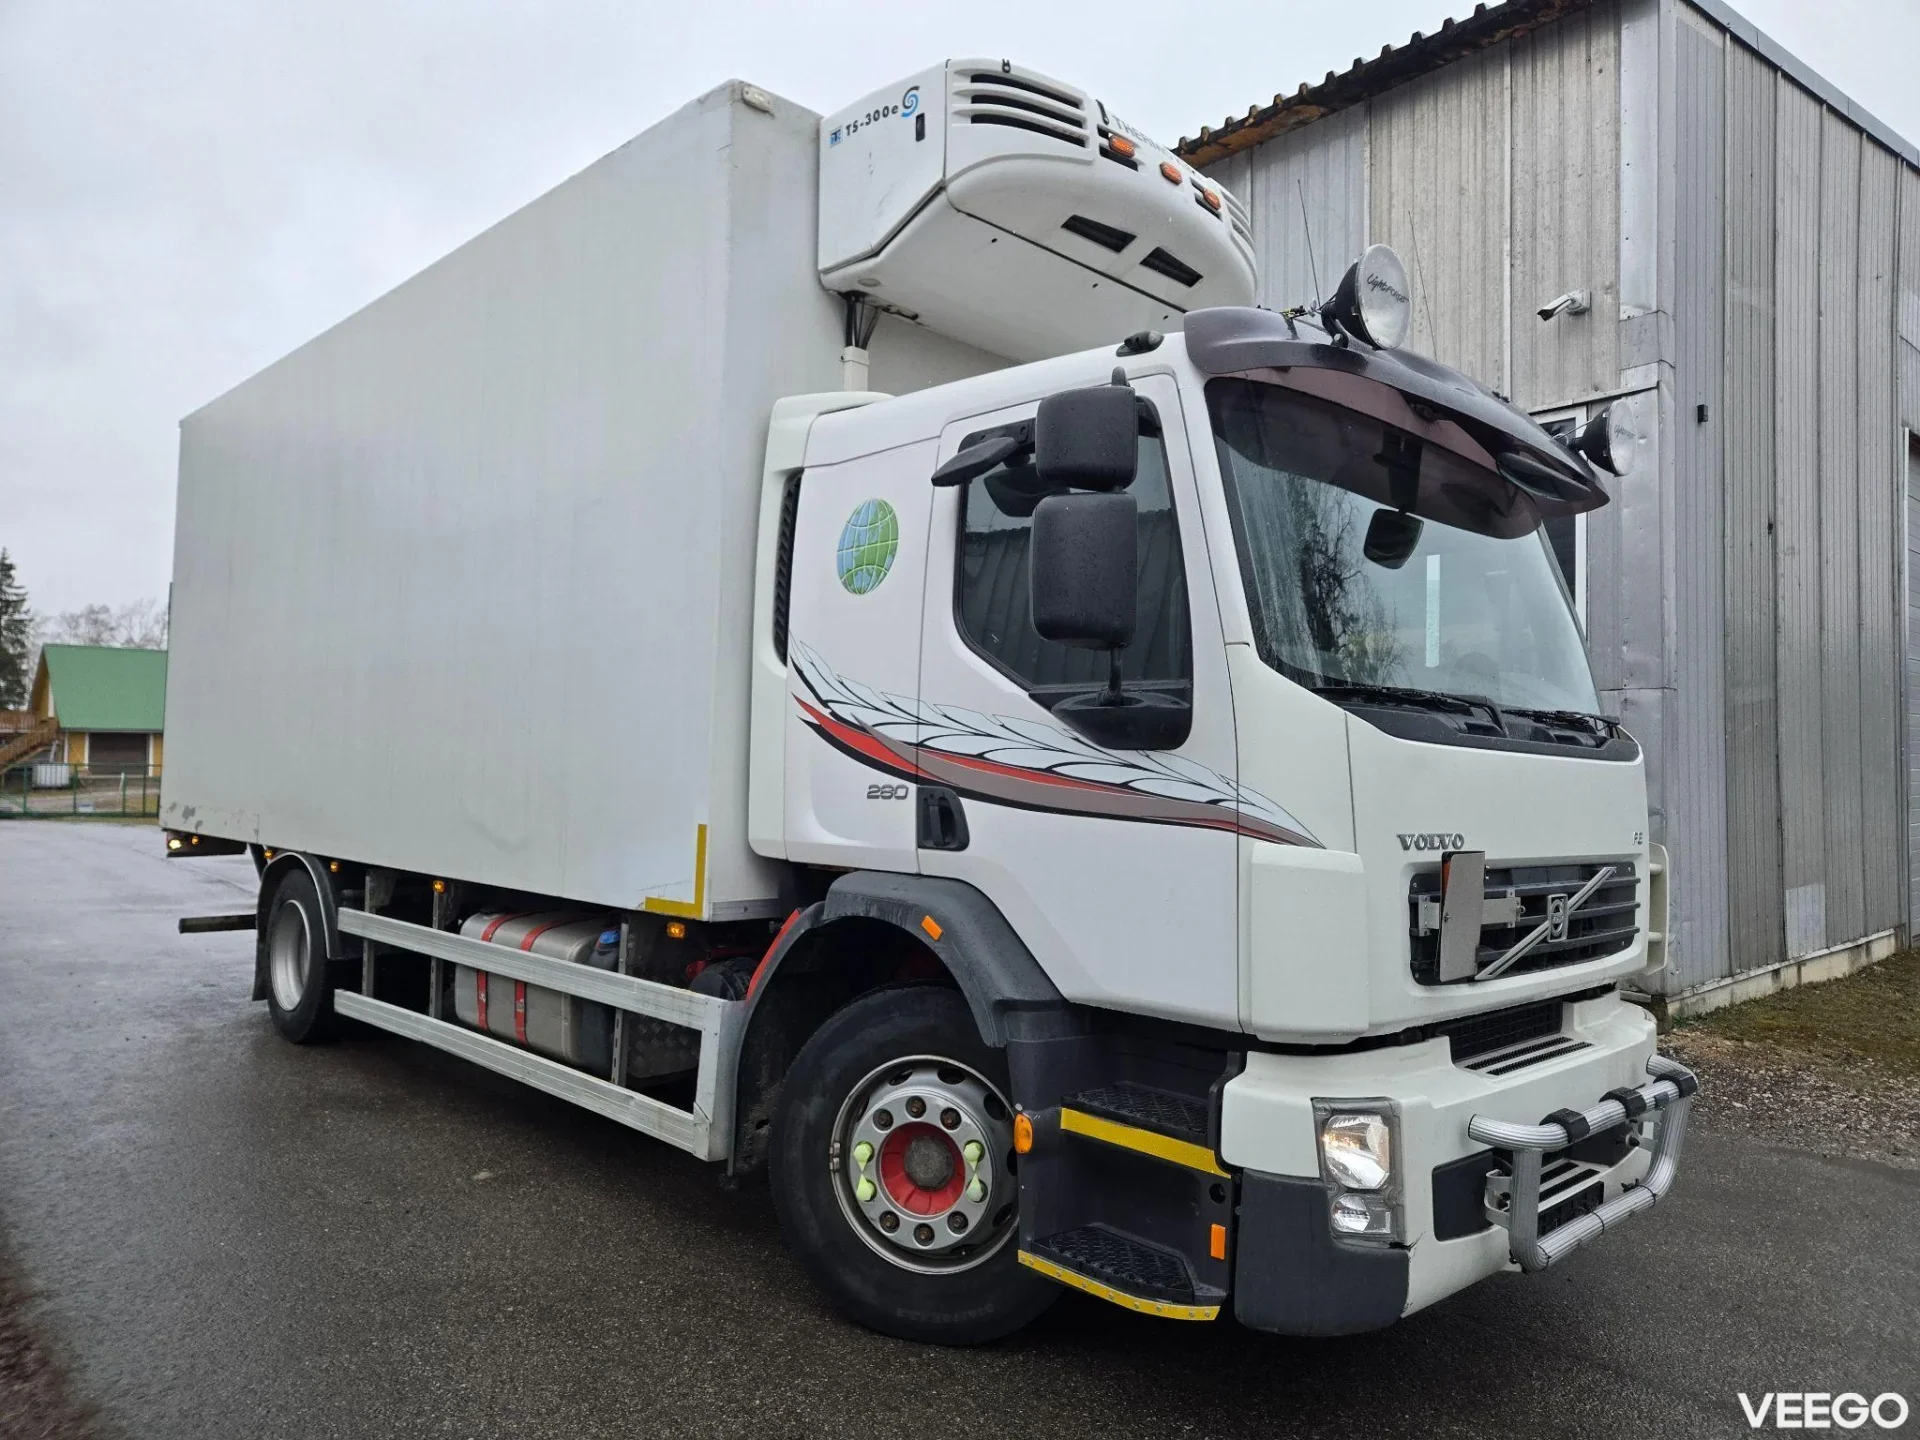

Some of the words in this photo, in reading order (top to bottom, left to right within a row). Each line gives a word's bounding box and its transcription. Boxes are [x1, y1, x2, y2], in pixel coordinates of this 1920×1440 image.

[846, 105, 898, 136] TS-300e
[867, 784, 909, 800] 280
[1396, 833, 1464, 851] VOLVO
